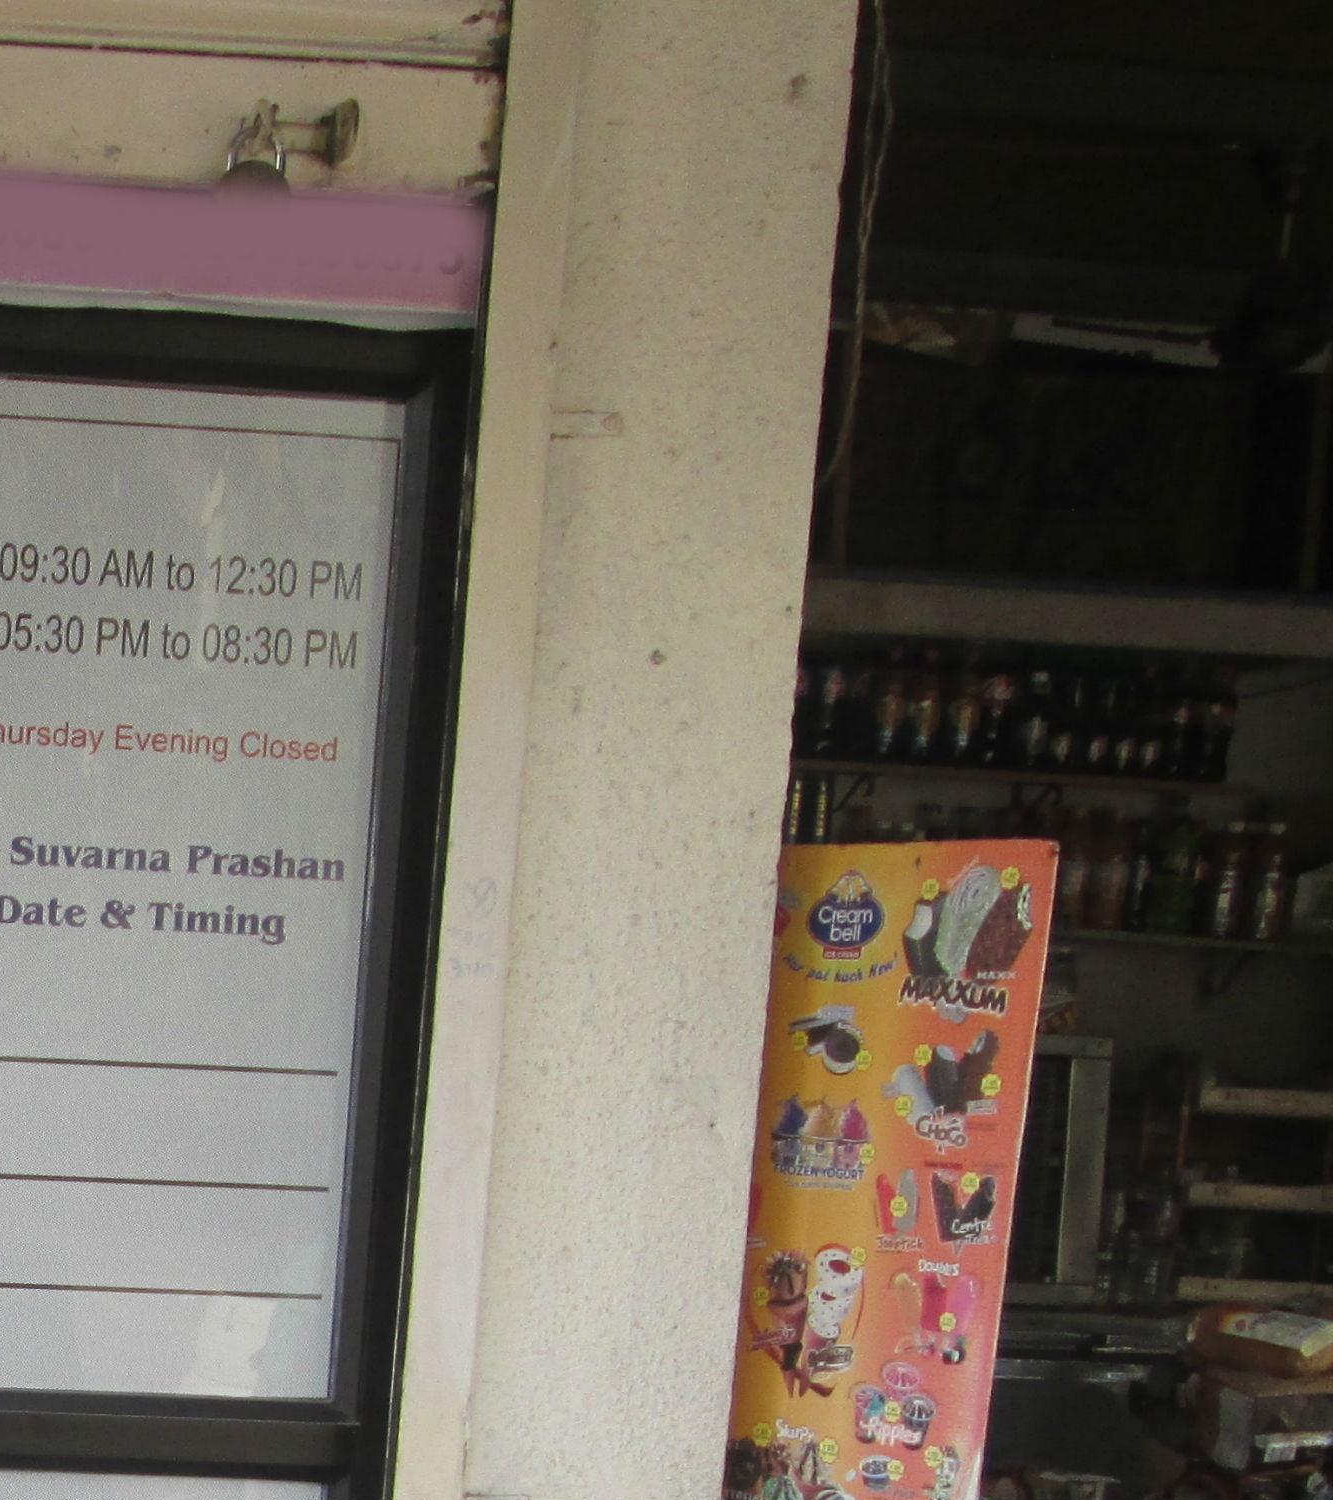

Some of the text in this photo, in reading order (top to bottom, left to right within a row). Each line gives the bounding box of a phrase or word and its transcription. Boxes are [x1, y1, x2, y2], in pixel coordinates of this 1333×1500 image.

[99, 548, 155, 590] AM
[166, 554, 195, 592] to
[209, 555, 298, 598] 12:30
[309, 560, 363, 602] PM
[96, 617, 151, 659] PM
[162, 622, 191, 661] to
[202, 623, 292, 668] 08:30
[303, 629, 359, 670] PM
[114, 724, 229, 763] Evening
[239, 731, 339, 763] Closed
[9, 835, 171, 875] Suvarna
[186, 844, 346, 882] Prashan
[99, 900, 138, 930] &
[147, 901, 288, 945] Timing
[817, 905, 874, 924] Cream
[829, 922, 861, 942] bell
